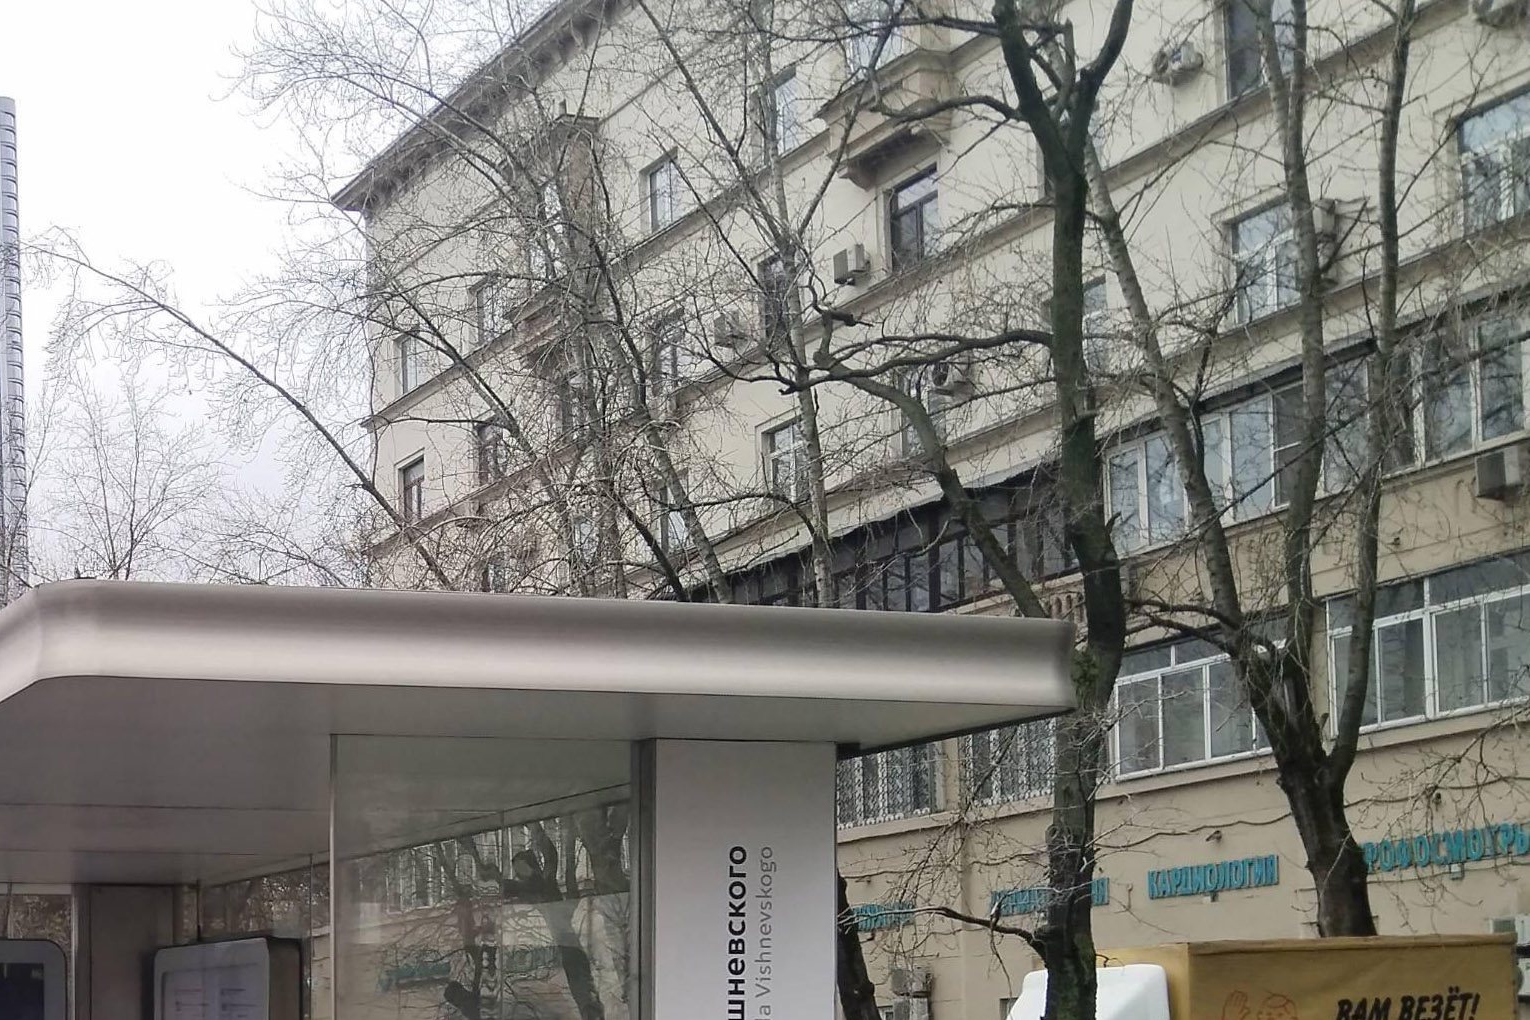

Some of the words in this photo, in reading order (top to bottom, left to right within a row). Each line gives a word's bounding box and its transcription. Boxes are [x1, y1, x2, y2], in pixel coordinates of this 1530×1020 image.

[1363, 822, 1530, 874] РОФОСМОТРЫ
[1147, 853, 1279, 900] КАРДИОЛОГИЯ
[754, 846, 777, 999] Vishnevskogo
